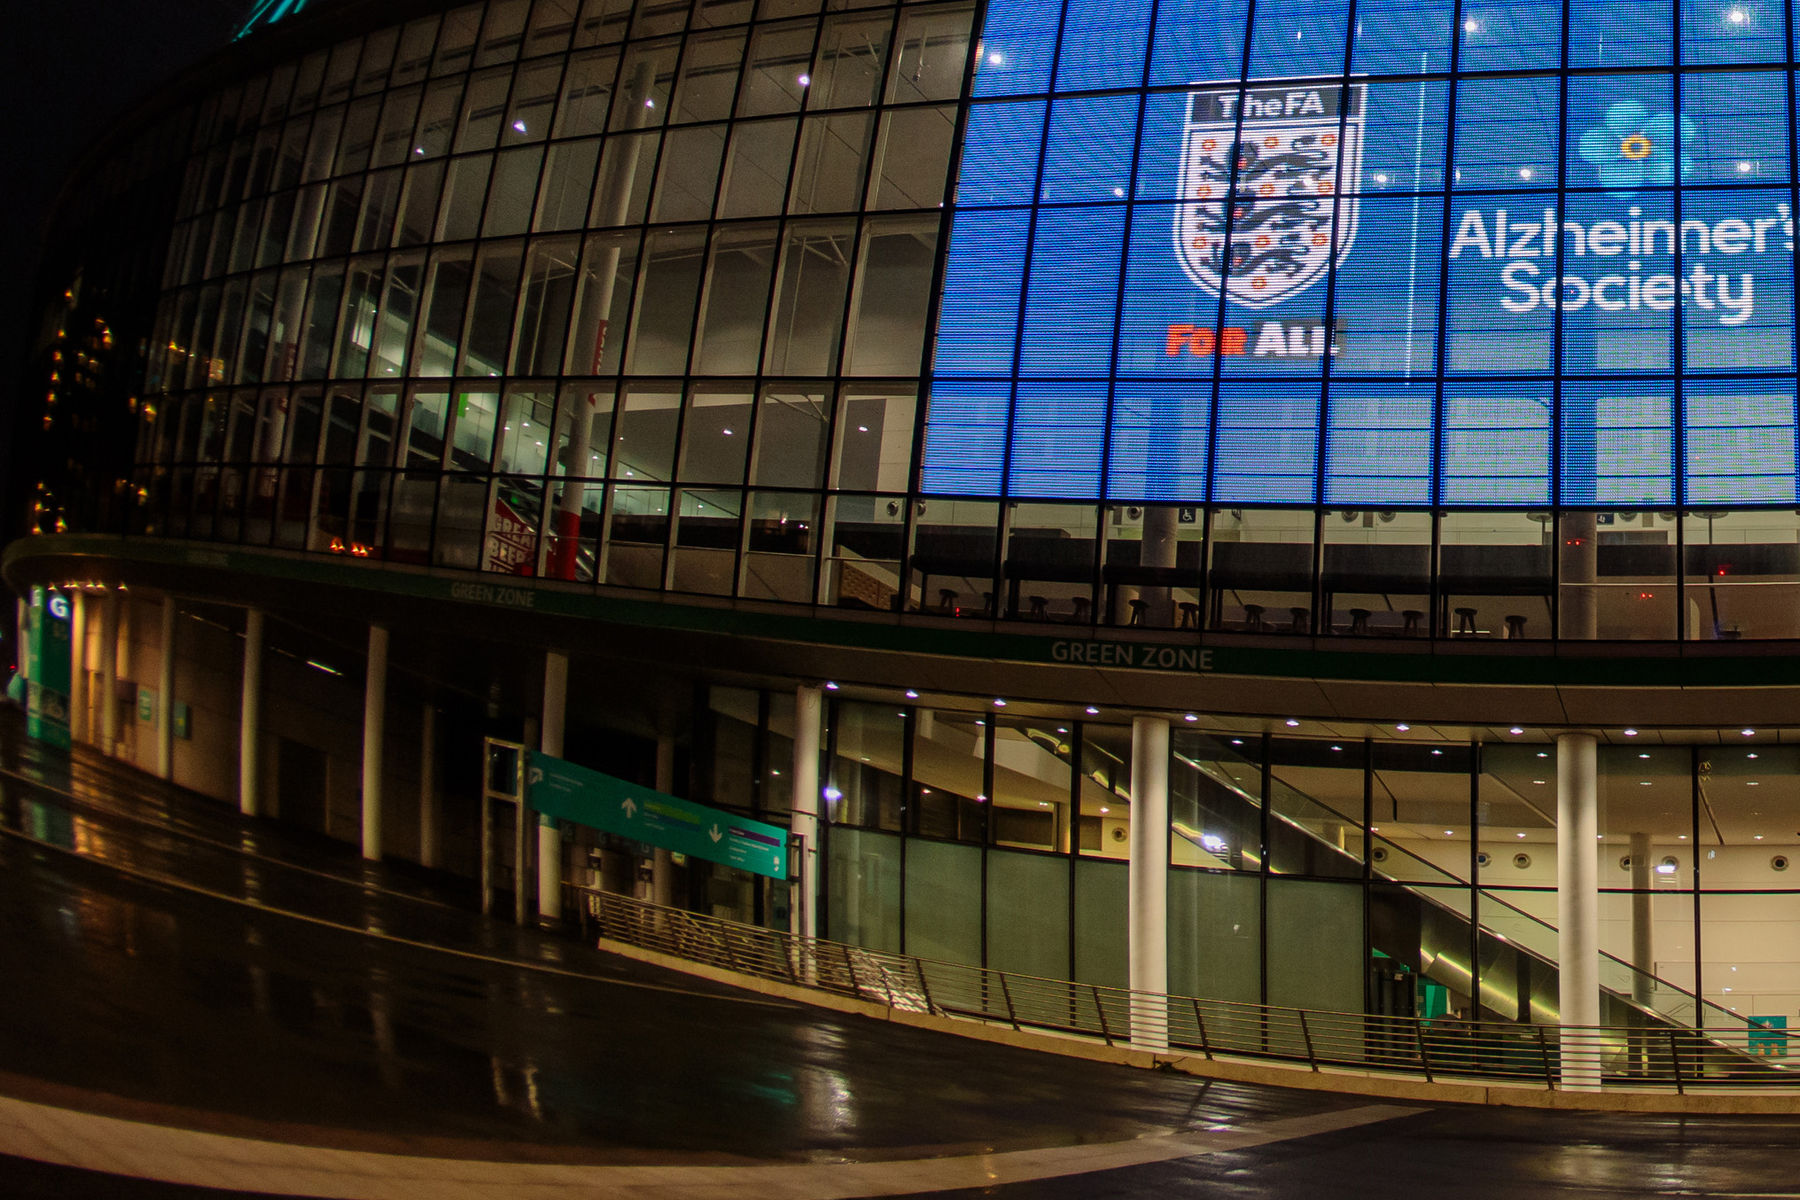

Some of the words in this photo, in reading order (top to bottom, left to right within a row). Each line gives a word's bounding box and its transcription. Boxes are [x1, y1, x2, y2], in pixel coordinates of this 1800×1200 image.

[1499, 259, 1755, 325] Society
[49, 593, 70, 619] G
[451, 581, 494, 603] GREEN
[494, 587, 536, 608] ZONE
[1051, 640, 1134, 665] GREEN
[1141, 647, 1213, 670] ZONE
